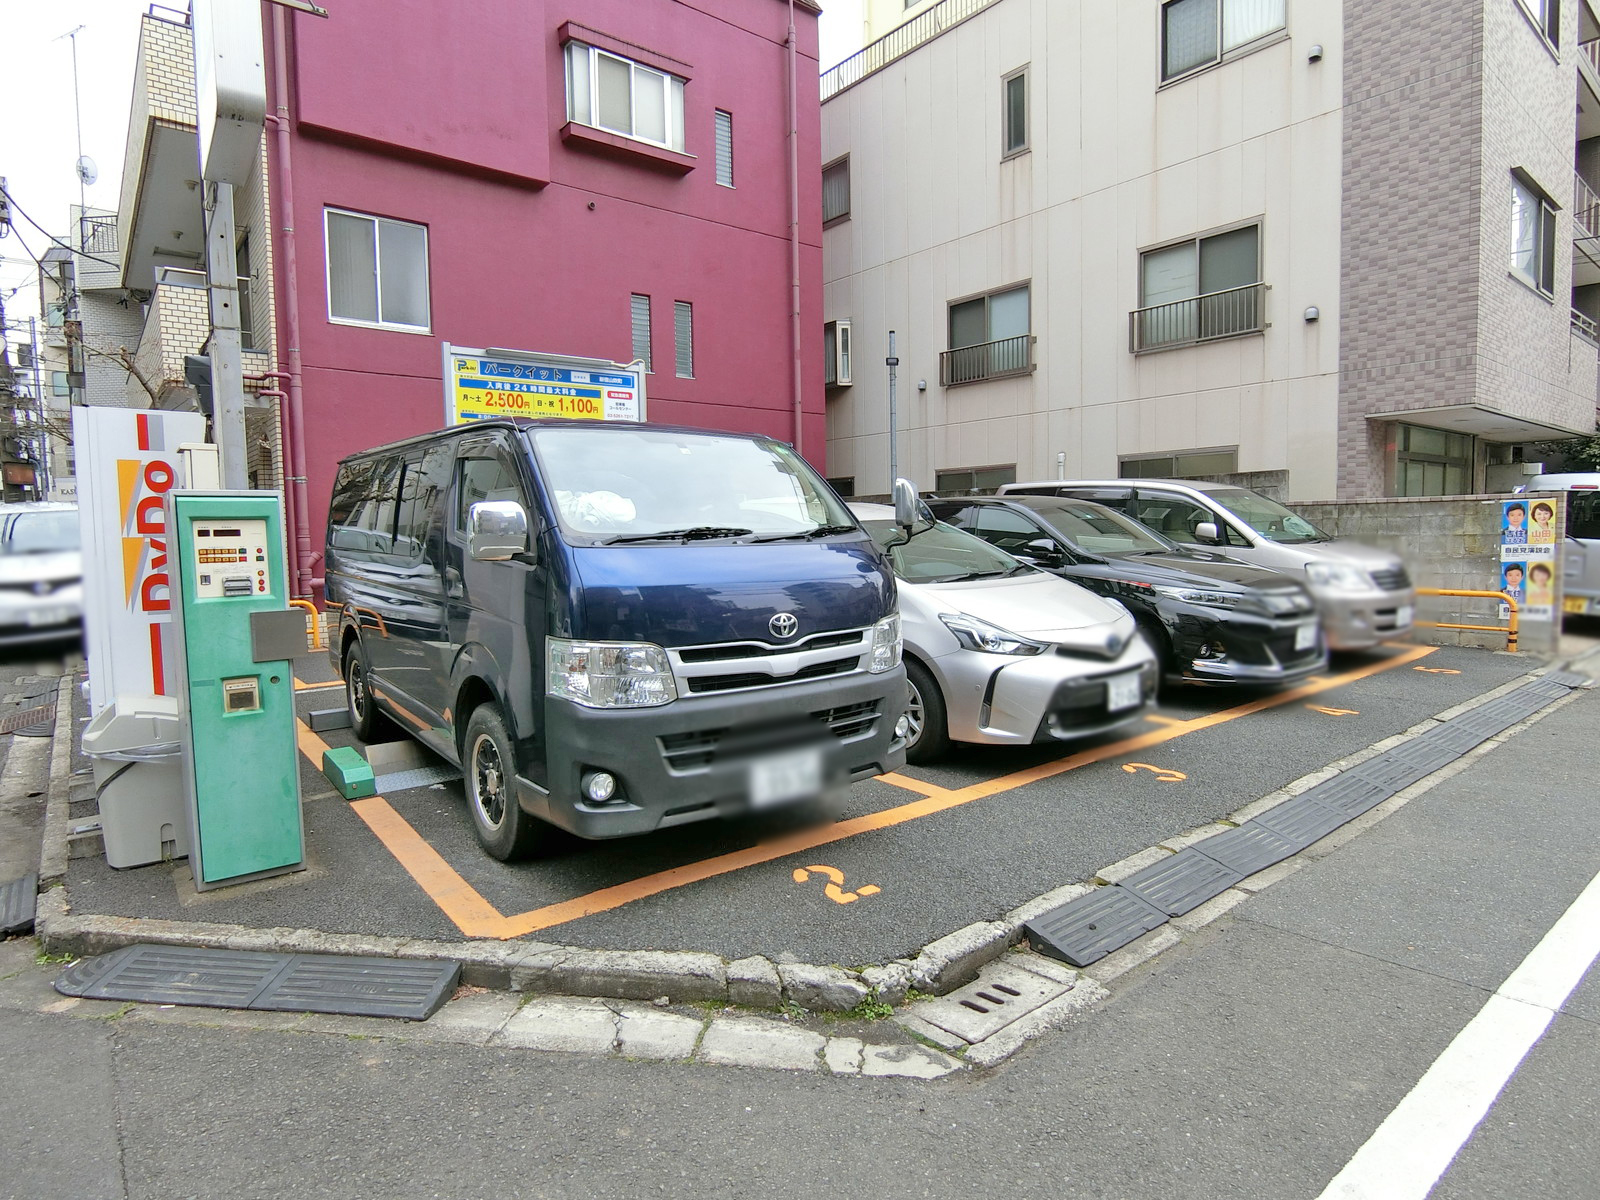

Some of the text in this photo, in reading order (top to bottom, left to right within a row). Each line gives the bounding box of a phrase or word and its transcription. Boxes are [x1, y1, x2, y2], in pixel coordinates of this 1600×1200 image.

[485, 363, 562, 380] パークイット
[137, 460, 174, 612] DyDo
[793, 865, 881, 904] 2
